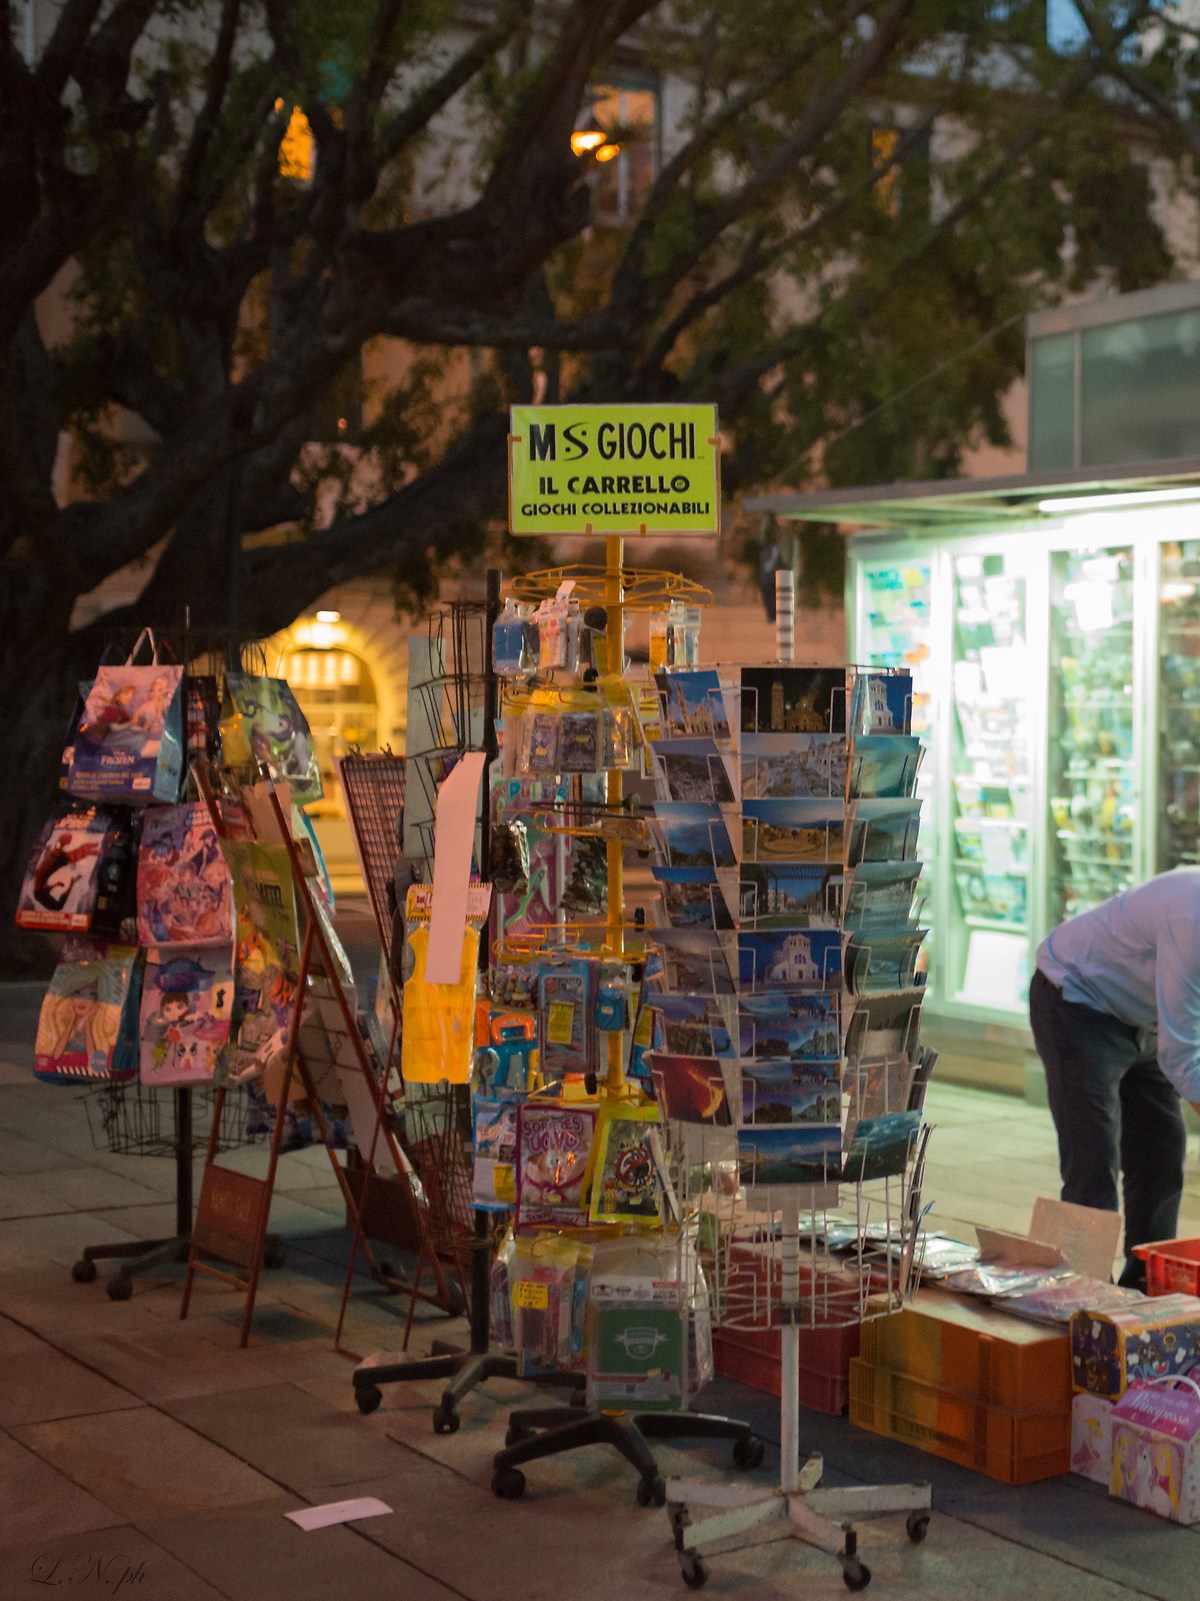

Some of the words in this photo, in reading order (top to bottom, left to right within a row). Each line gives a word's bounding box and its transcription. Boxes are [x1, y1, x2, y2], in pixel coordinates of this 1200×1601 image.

[597, 422, 696, 460] GIOCHI
[539, 476, 560, 495] IL
[567, 474, 691, 495] CARRELLO
[521, 503, 577, 516] GIOCHI
[581, 501, 711, 516] COLLEZIONABILI
